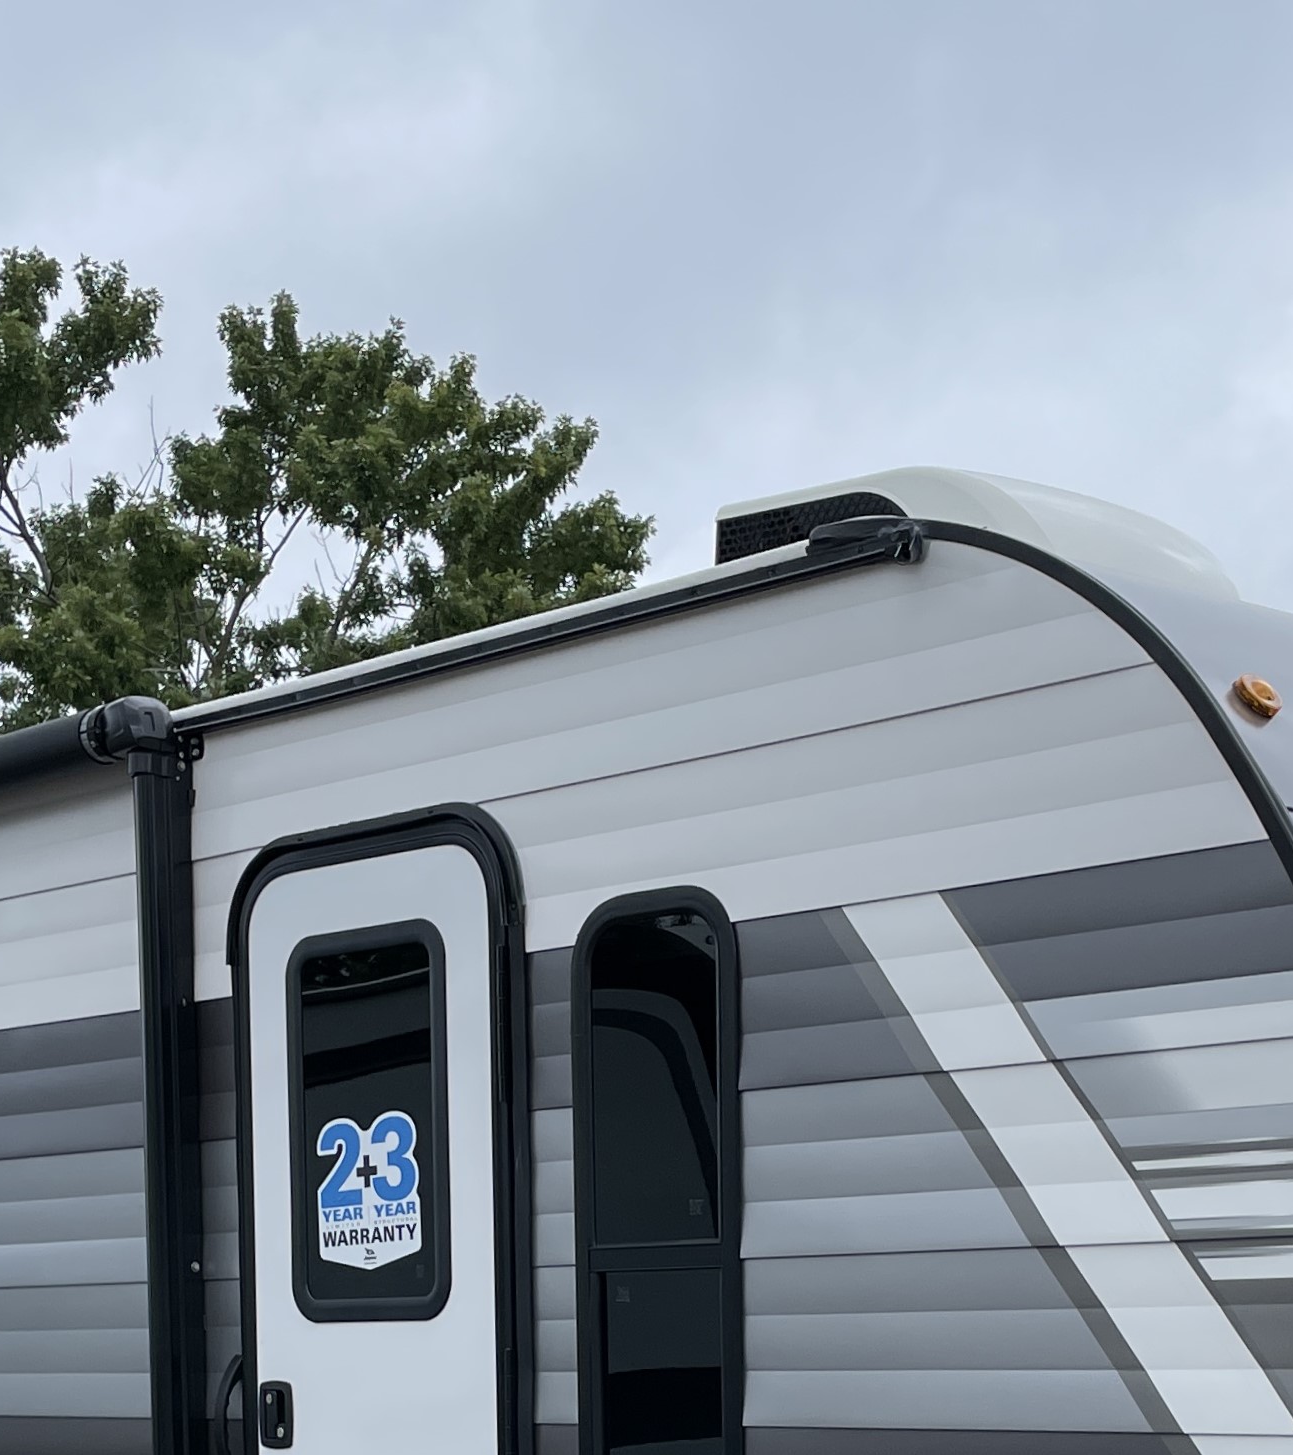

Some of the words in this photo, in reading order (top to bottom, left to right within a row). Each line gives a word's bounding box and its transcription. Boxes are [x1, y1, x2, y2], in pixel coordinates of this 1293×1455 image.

[322, 1207, 363, 1223] YEAR
[374, 1201, 417, 1217] YEAR
[322, 1223, 417, 1248] WARRANTY
